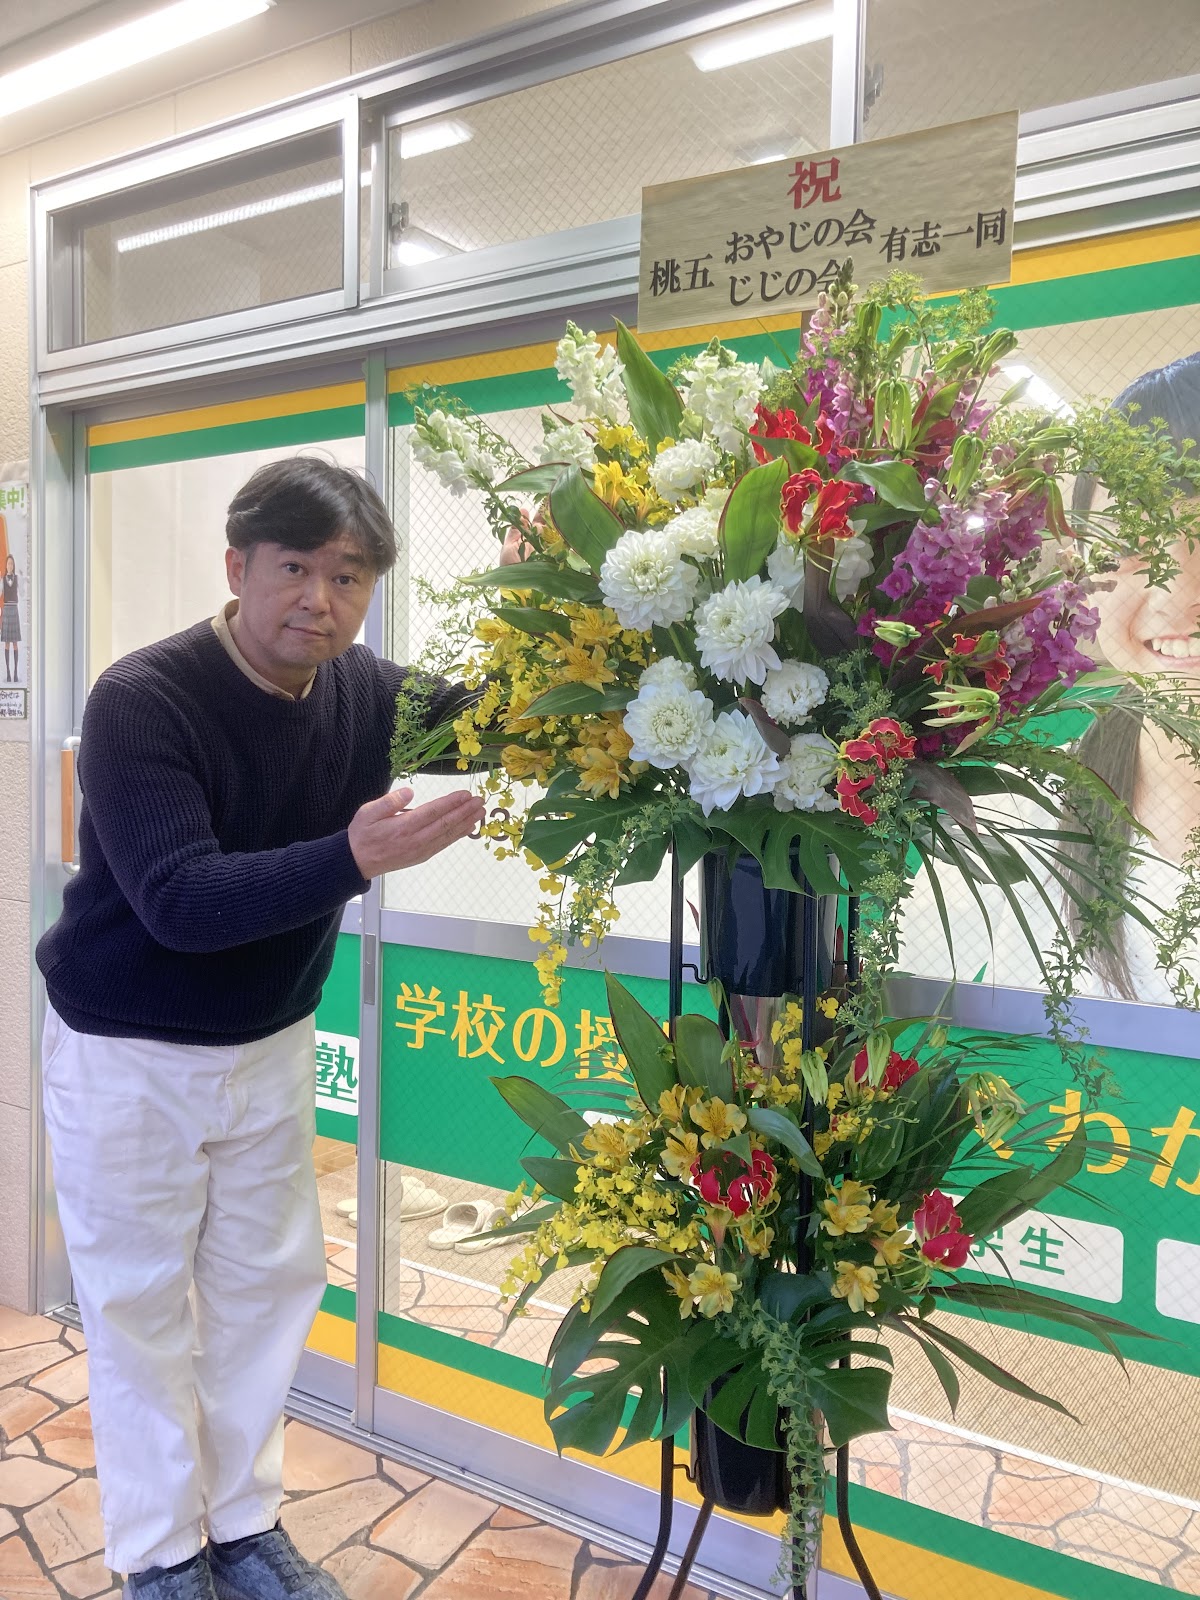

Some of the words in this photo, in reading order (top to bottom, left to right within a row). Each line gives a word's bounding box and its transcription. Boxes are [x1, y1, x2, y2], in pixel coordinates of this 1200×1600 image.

[787, 156, 842, 210] 祝
[649, 252, 715, 298] 桃五
[725, 208, 877, 266] おやじの会
[879, 207, 1008, 264] 有志一同
[316, 1041, 359, 1104] 塾
